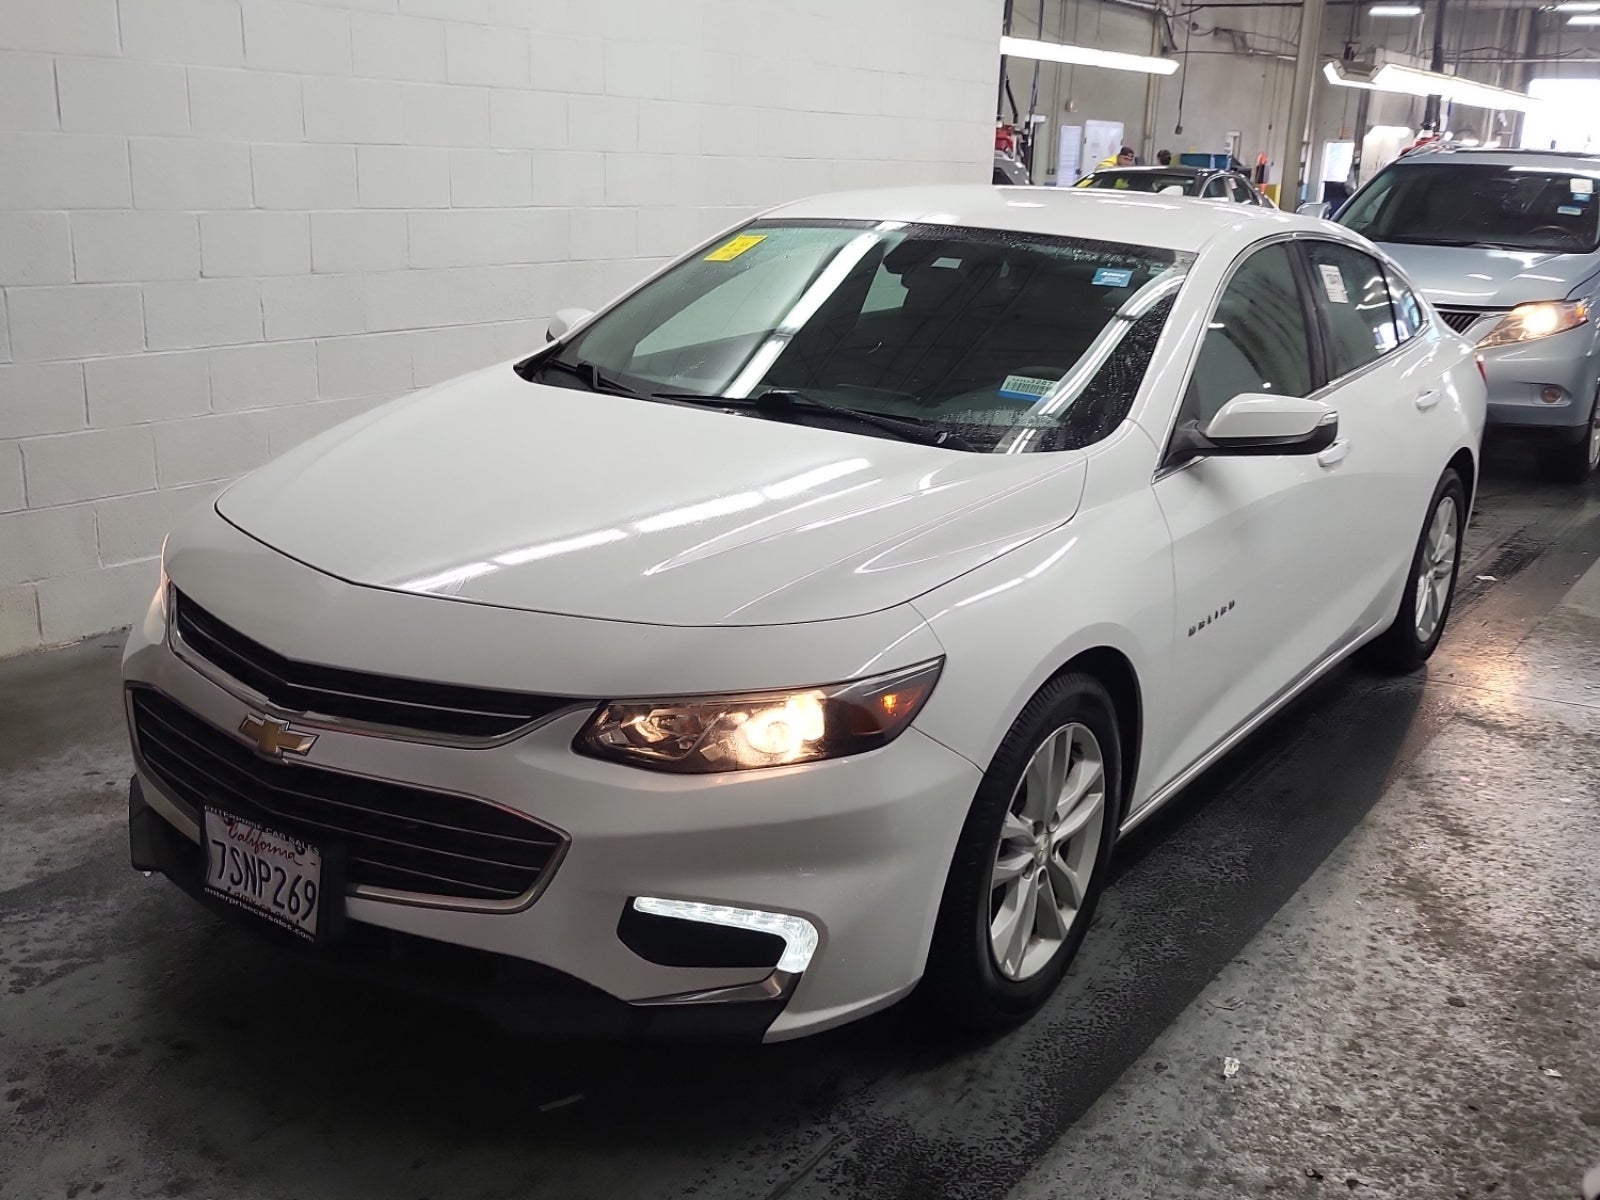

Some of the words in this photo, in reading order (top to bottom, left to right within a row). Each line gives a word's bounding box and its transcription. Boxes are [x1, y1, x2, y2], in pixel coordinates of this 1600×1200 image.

[226, 819, 304, 866] California
[212, 840, 317, 921] 7SNP269
[204, 887, 315, 943] enterprisecarsales.com
